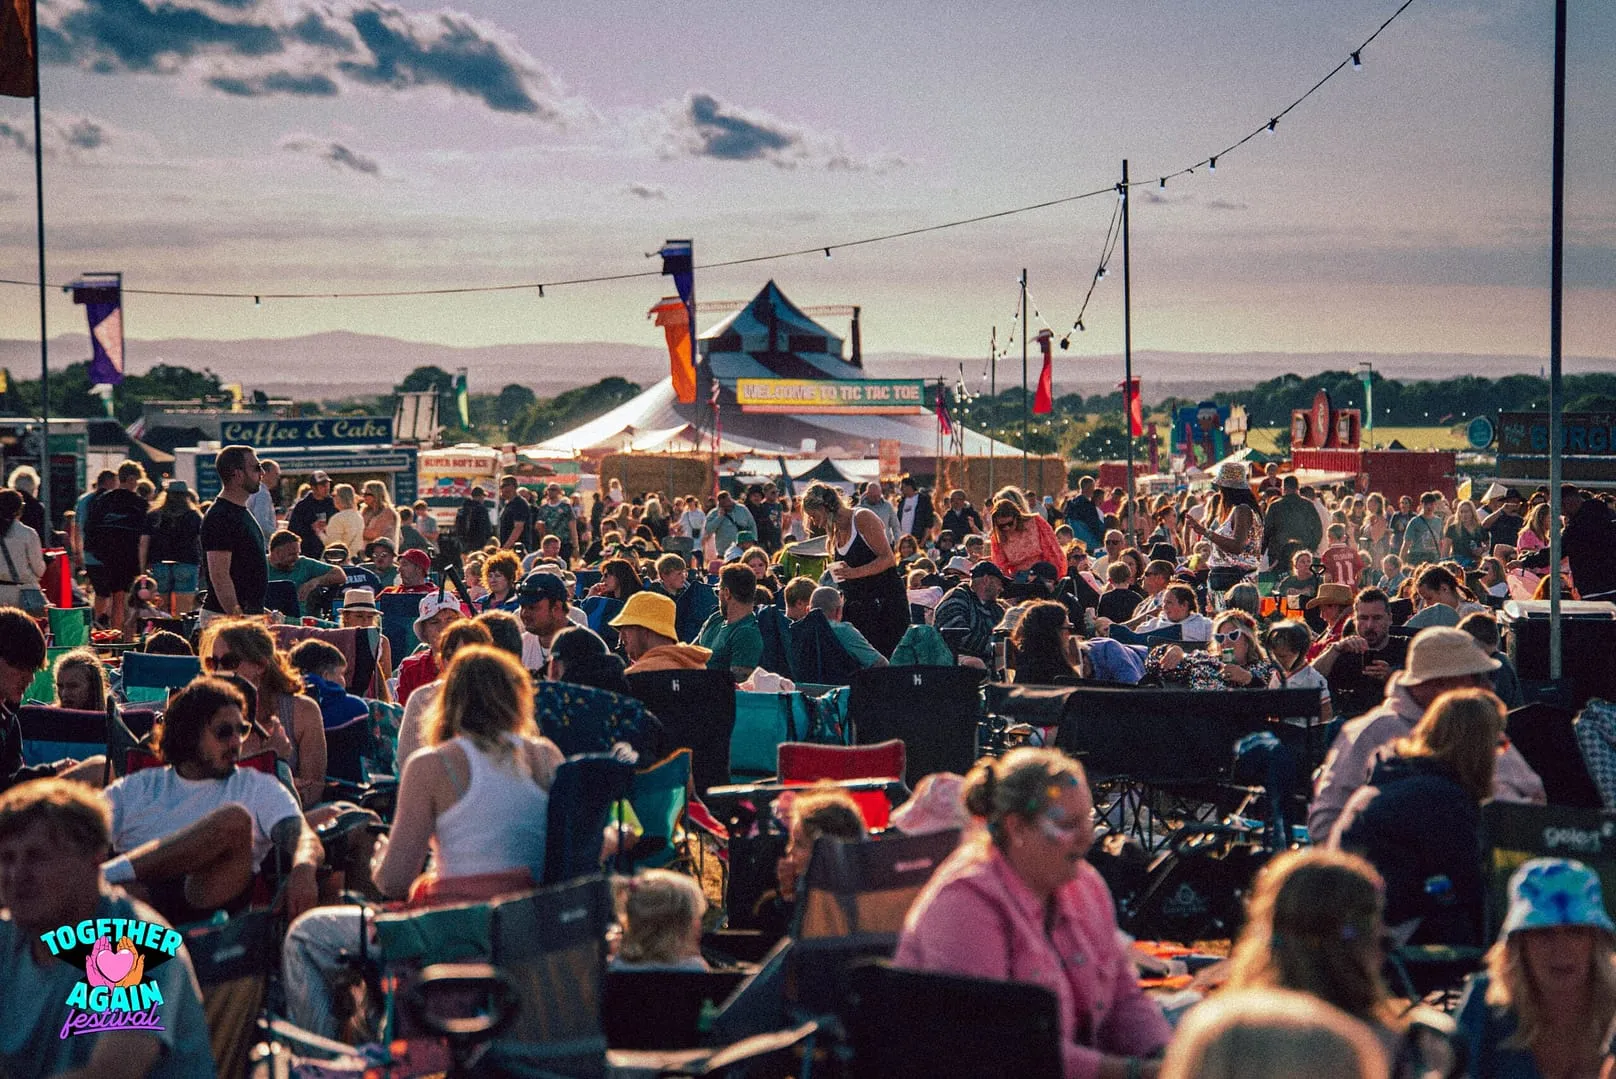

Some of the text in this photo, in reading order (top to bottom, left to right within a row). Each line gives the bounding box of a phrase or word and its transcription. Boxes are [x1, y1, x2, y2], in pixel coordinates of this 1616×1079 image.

[743, 384, 920, 401] WELCOME TO TIC TAC TOE
[224, 419, 389, 446] Coffee & Cake
[1335, 561, 1355, 585] 11
